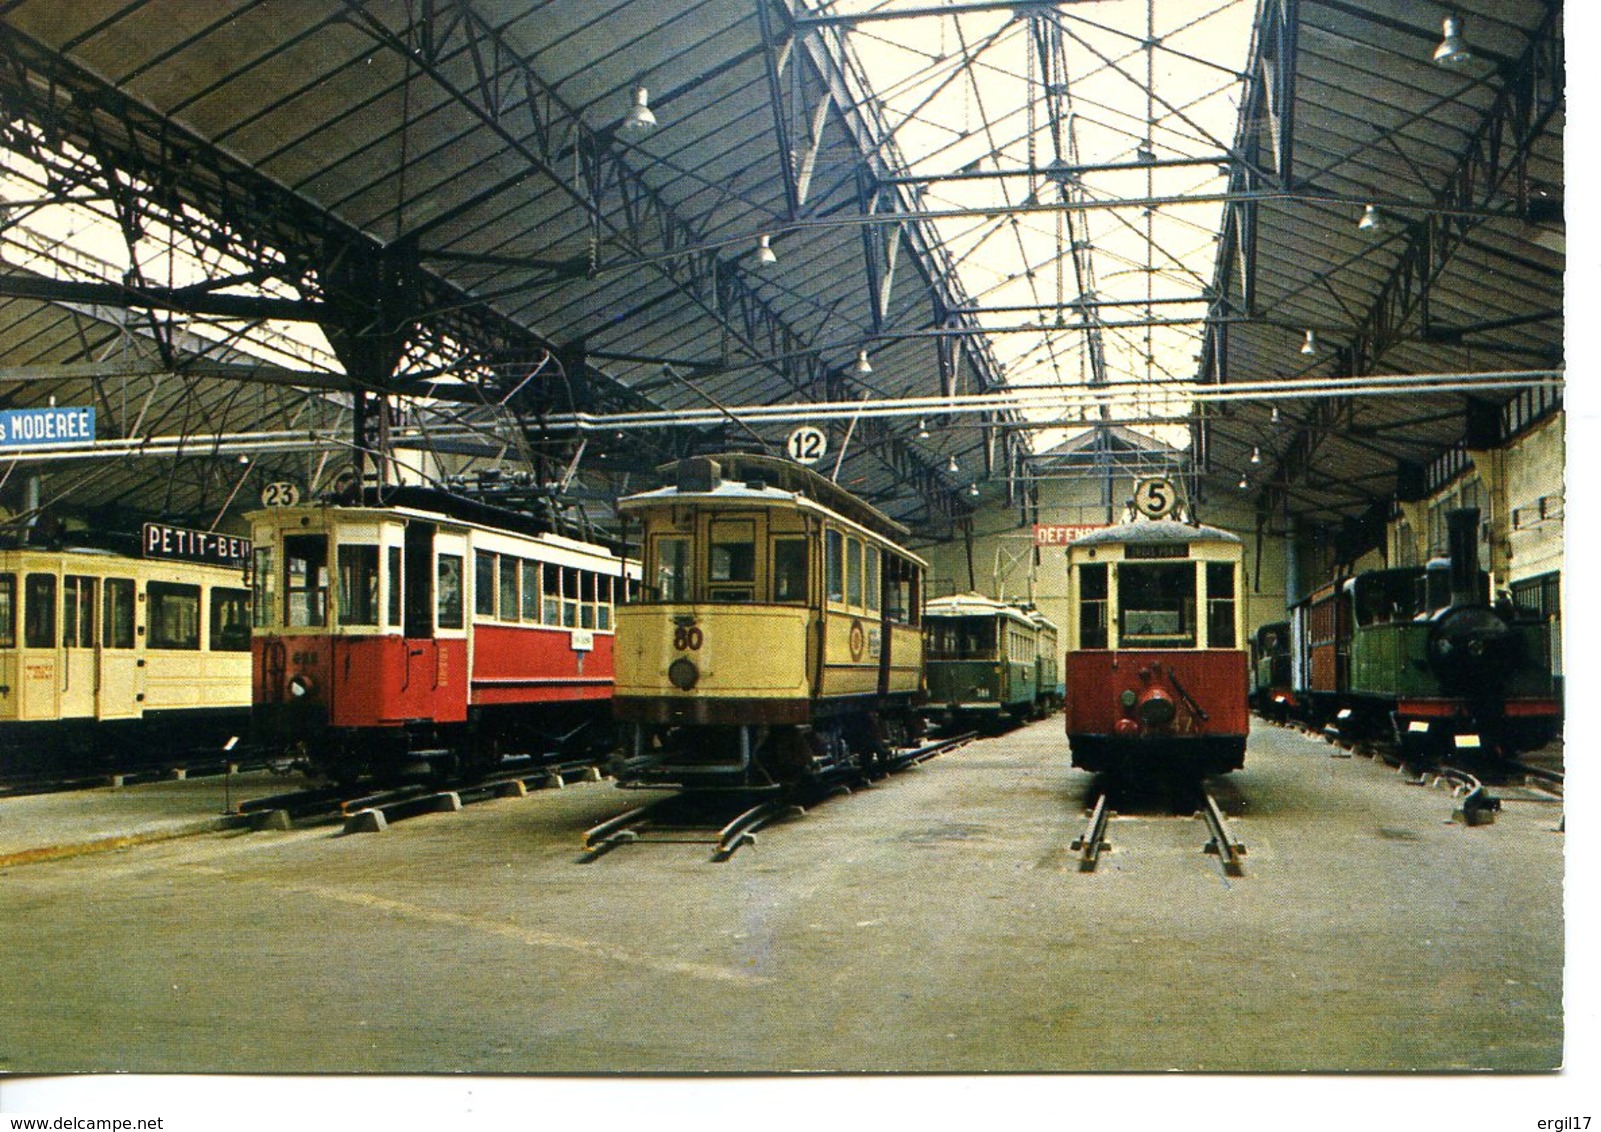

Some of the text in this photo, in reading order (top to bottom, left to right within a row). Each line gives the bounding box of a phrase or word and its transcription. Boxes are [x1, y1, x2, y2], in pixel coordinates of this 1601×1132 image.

[795, 432, 820, 458] 12
[266, 485, 293, 506] 23
[1148, 483, 1167, 512] 5
[673, 626, 703, 651] 80
